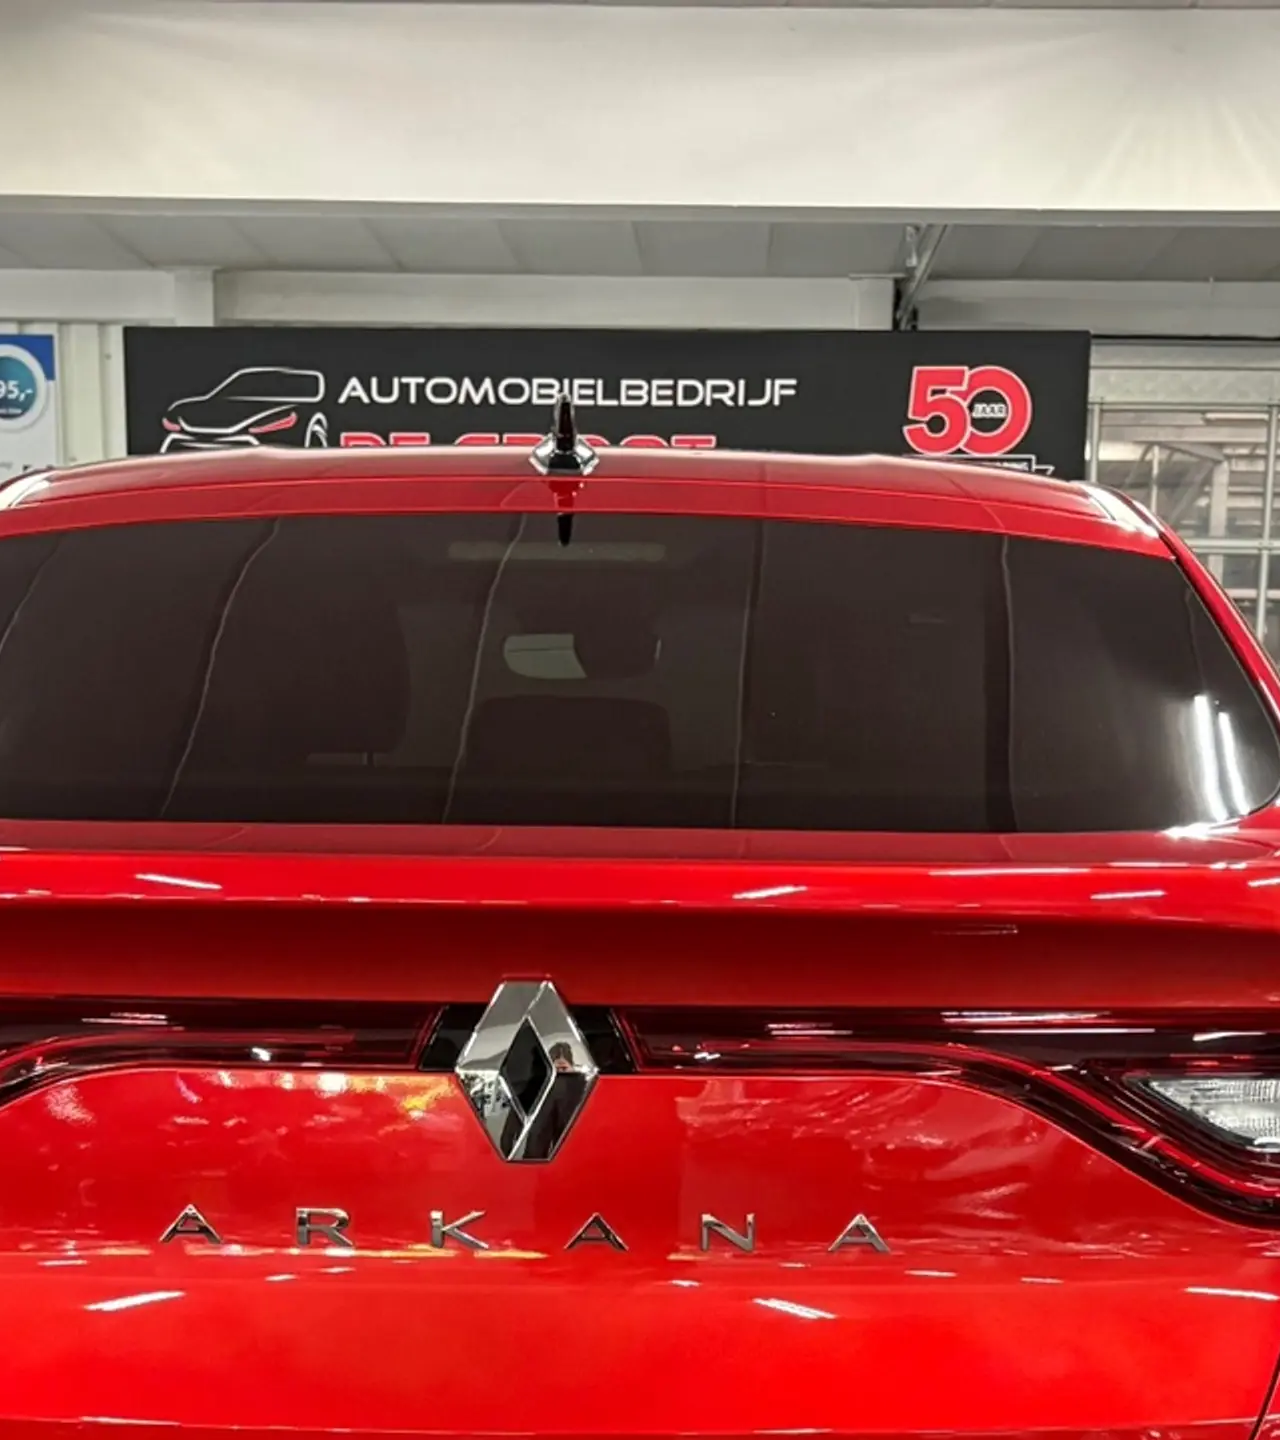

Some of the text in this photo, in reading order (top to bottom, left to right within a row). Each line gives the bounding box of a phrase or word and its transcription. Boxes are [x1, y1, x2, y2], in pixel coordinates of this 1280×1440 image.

[337, 376, 799, 408] AUTOMOBIELBEDRIJF
[902, 365, 1033, 456] 50
[971, 402, 1009, 418] JAAR
[159, 1202, 893, 1255] ARKANA
